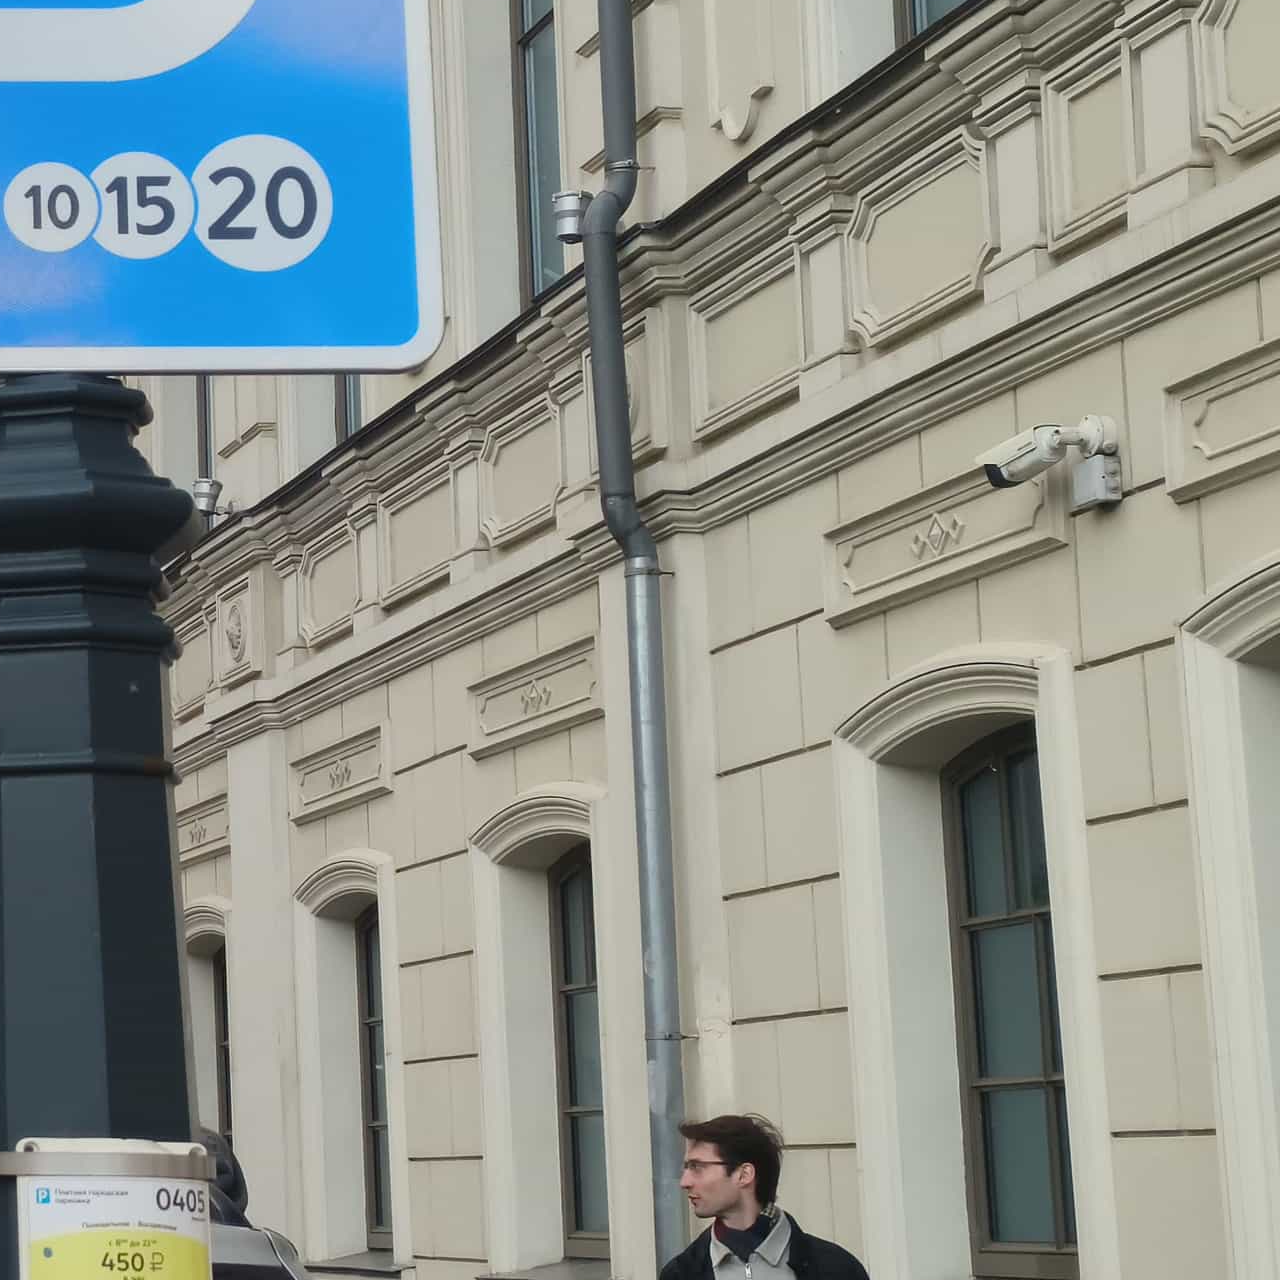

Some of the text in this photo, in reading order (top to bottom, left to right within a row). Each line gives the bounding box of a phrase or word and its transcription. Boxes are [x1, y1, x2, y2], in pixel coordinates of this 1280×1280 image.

[24, 166, 317, 239] 10 15 20
[156, 1188, 206, 1213] 0405
[101, 1252, 144, 1271] 450
